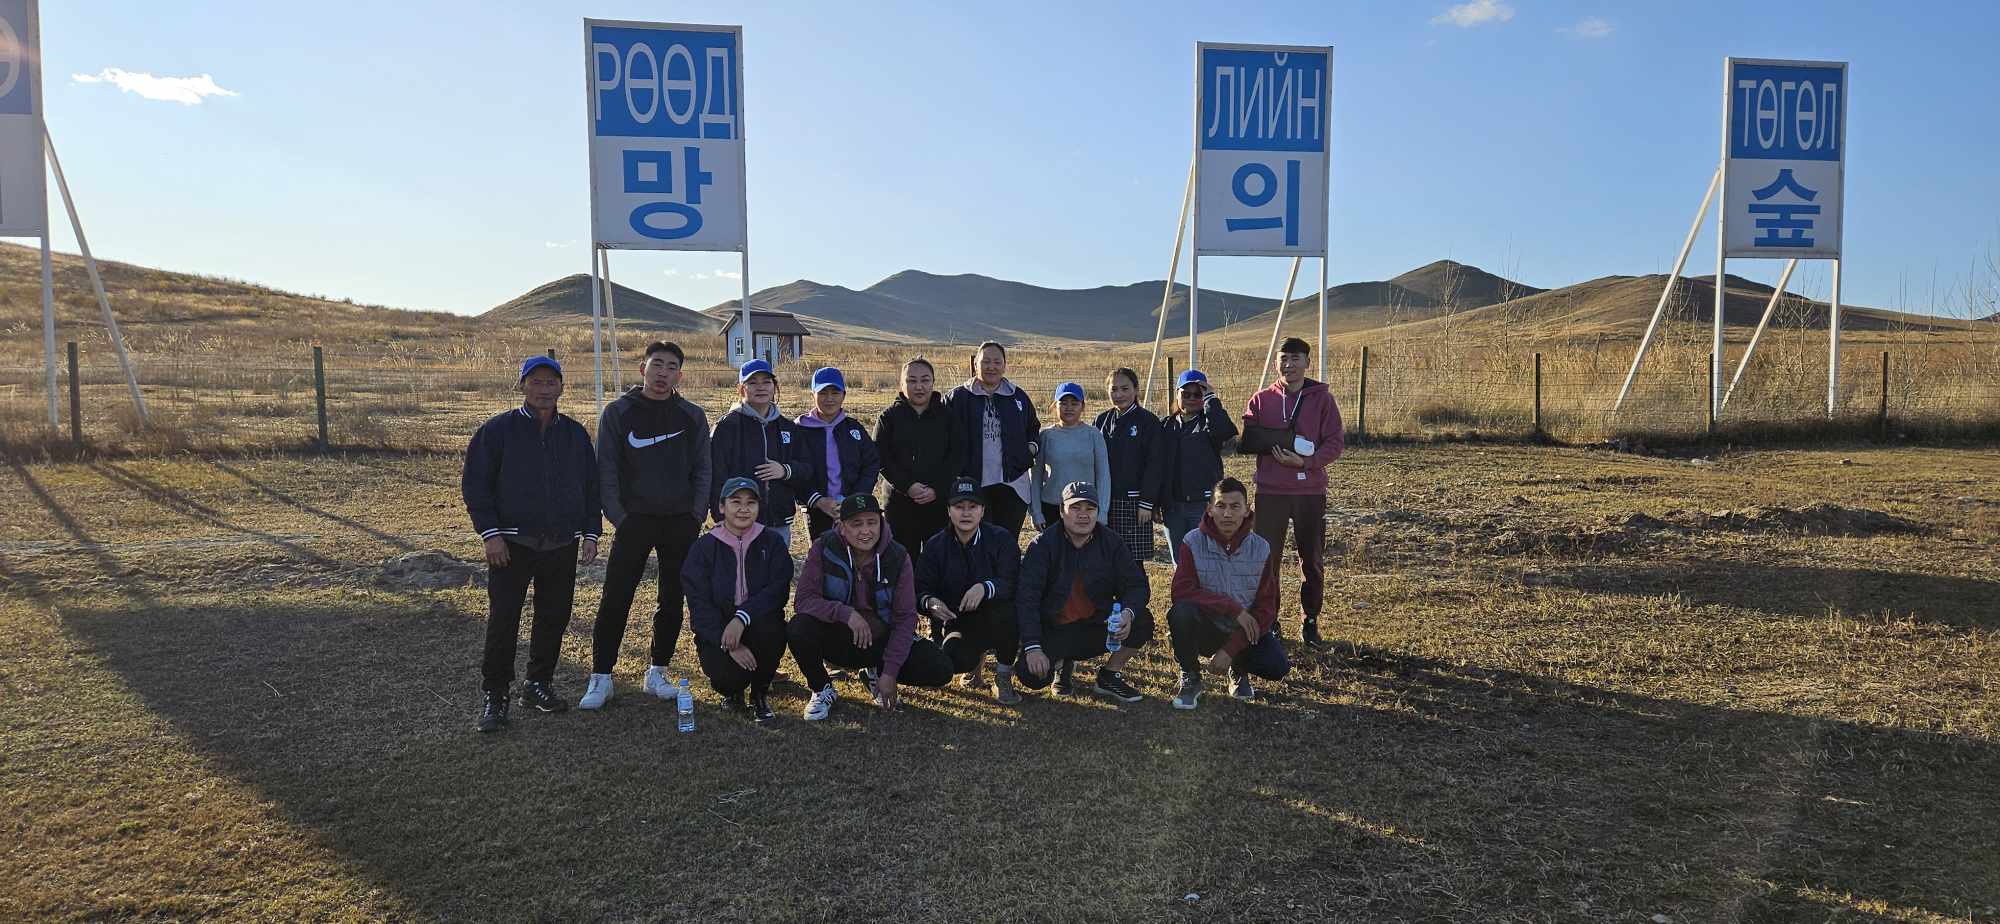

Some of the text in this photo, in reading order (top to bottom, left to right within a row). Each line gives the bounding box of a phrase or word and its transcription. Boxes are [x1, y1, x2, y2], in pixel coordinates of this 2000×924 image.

[593, 42, 735, 144] РӨӨД
[1208, 52, 1320, 140] ЛИЙН
[1738, 78, 1837, 150] ТӨГӨЛ
[622, 146, 712, 240] 망
[1226, 159, 1301, 247] 의
[1748, 168, 1821, 248] 숲
